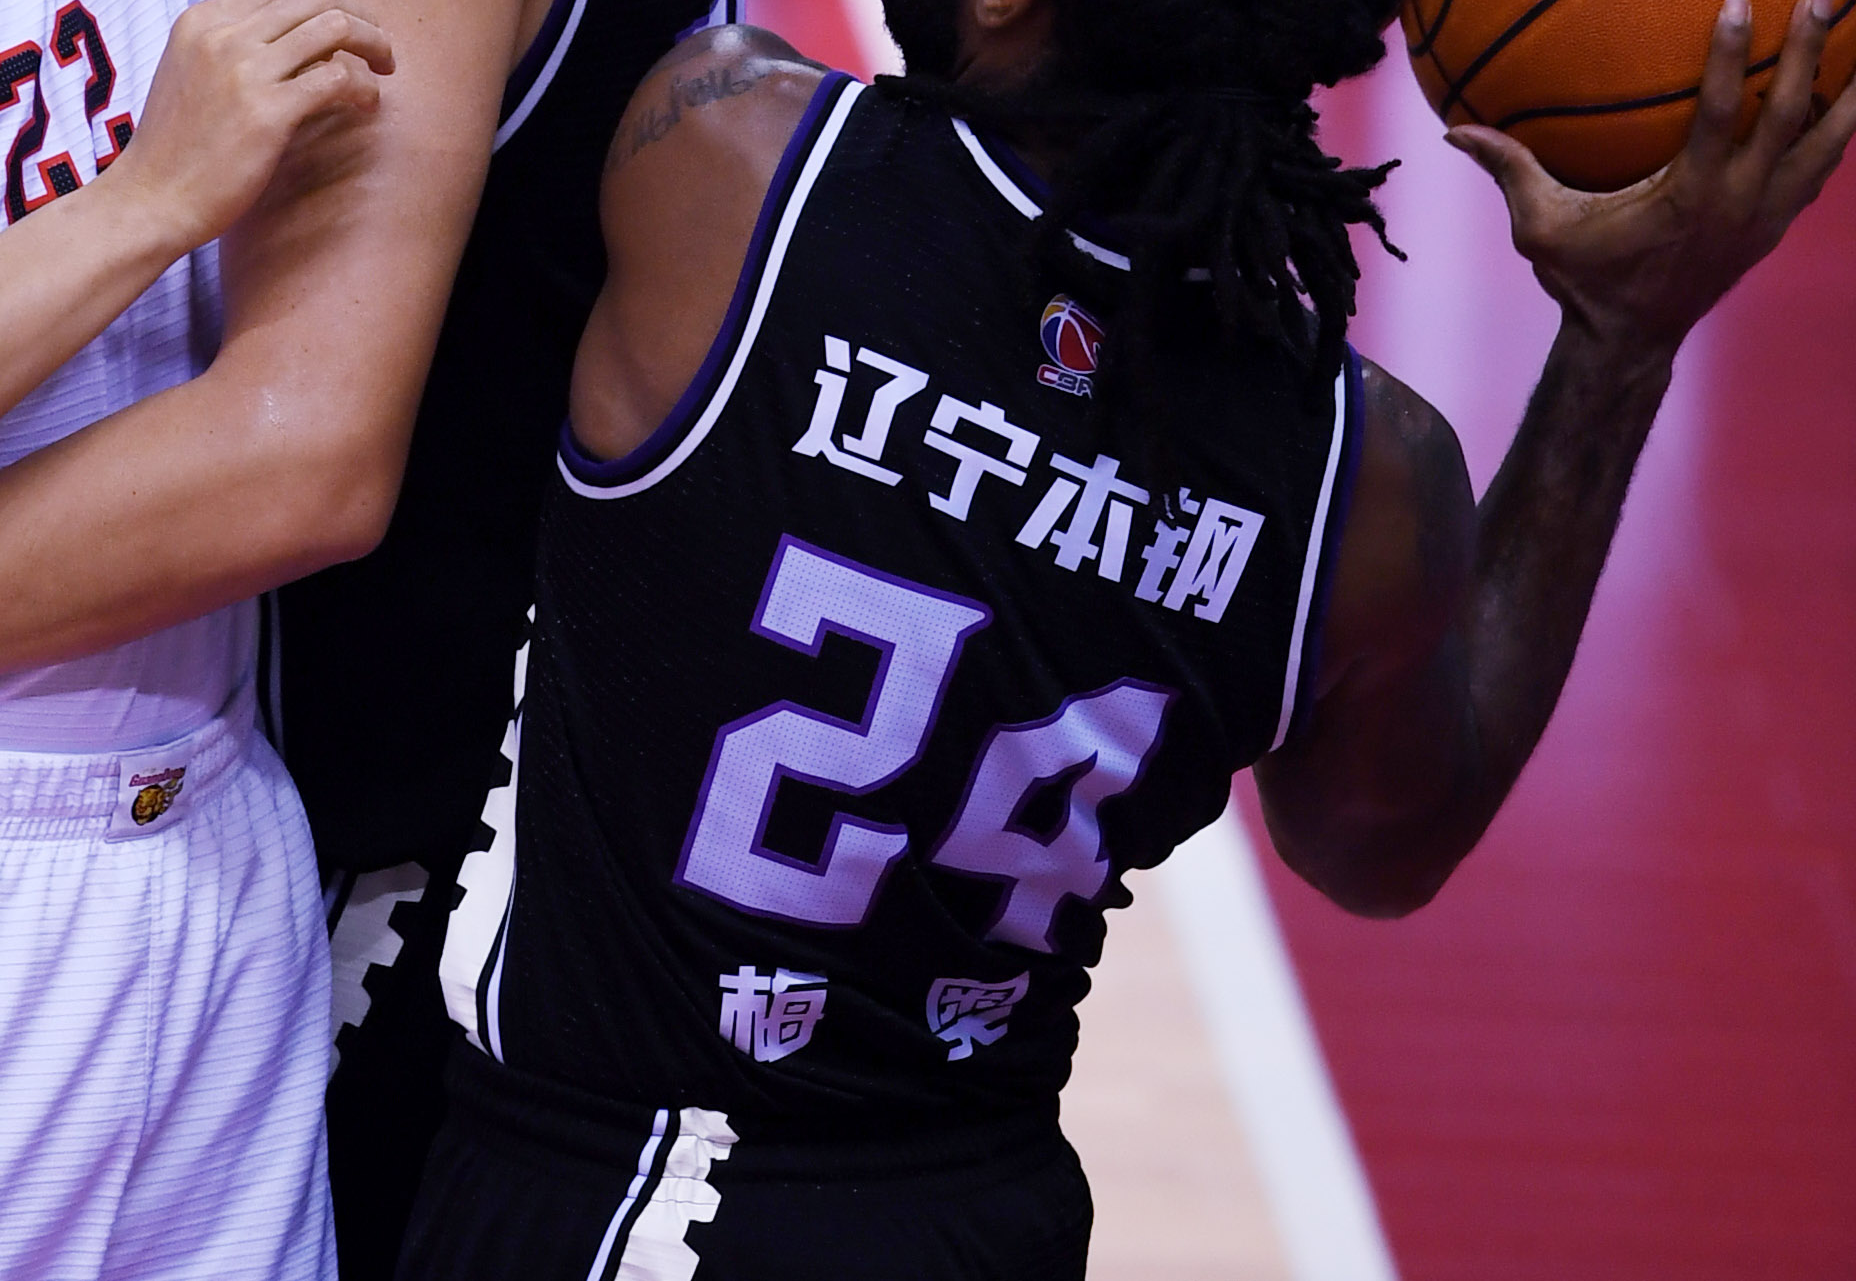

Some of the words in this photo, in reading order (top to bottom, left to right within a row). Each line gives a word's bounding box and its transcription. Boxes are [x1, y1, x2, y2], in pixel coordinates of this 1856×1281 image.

[791, 334, 1266, 624] 辽宁本钢
[672, 532, 1180, 954] 24
